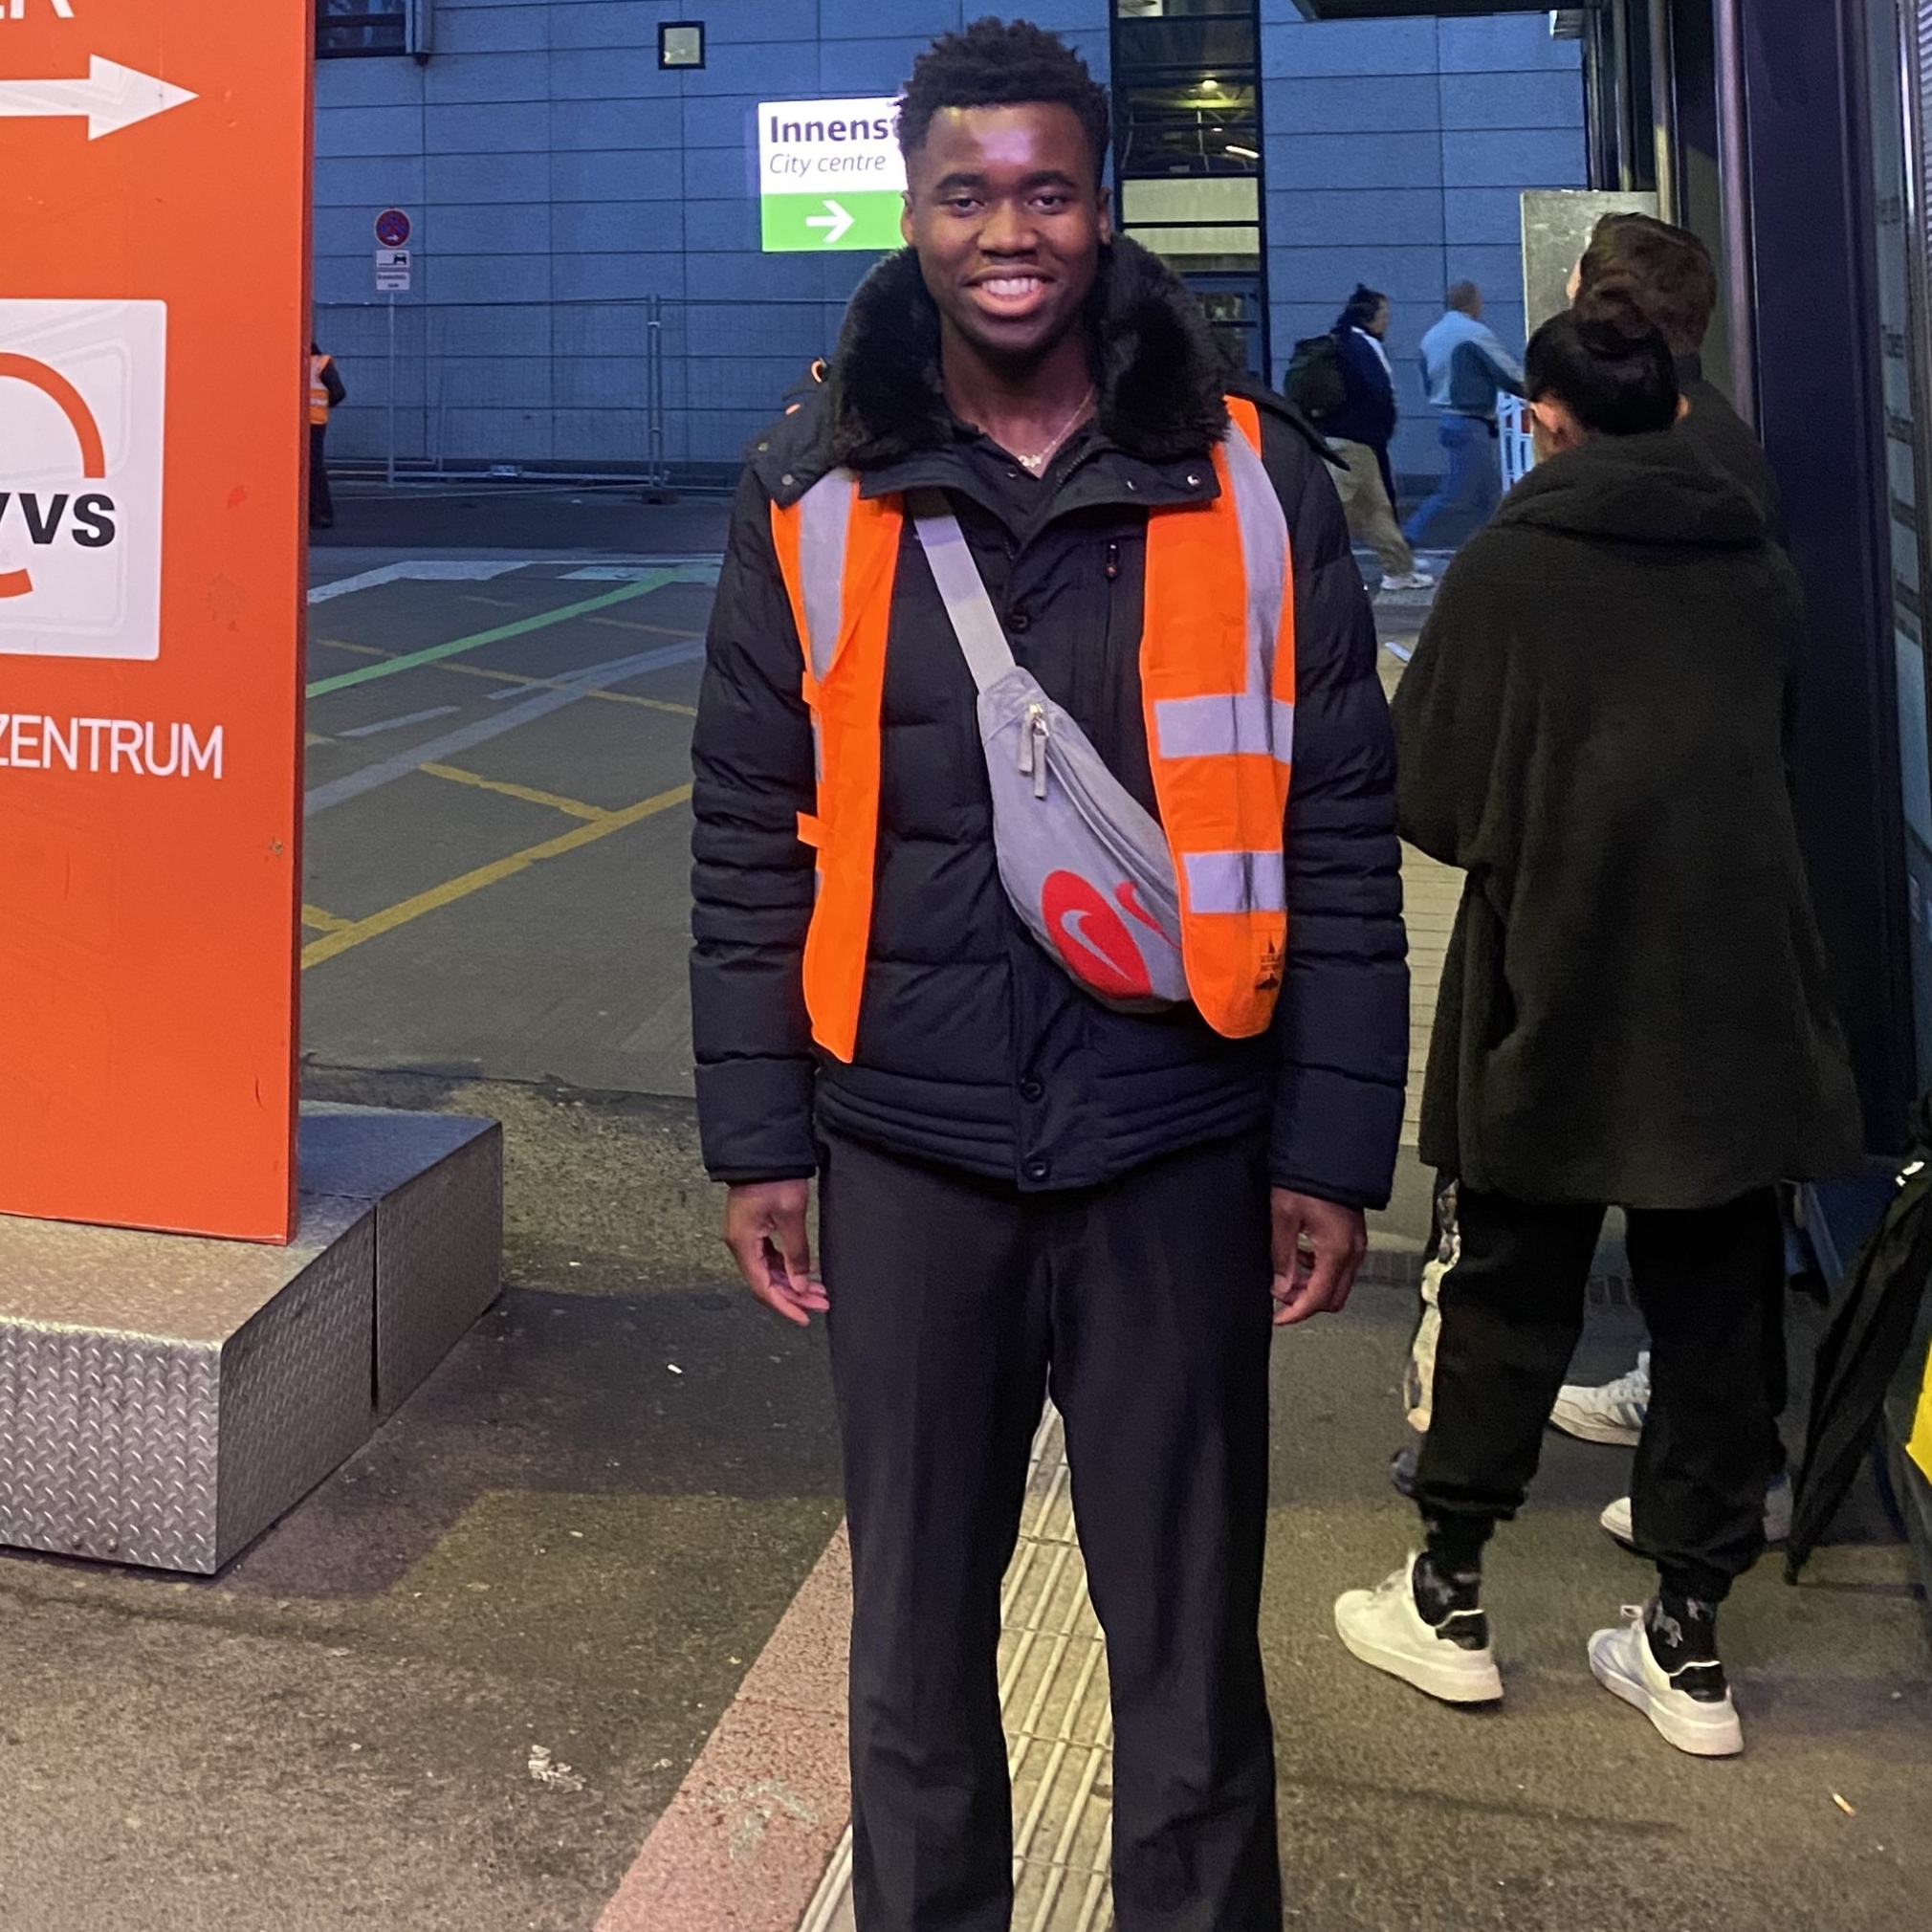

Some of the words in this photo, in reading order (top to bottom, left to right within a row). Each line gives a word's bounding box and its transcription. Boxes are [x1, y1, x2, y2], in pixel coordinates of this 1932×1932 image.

[770, 116, 889, 143] Innens
[769, 153, 811, 177] City
[817, 154, 886, 172] centre
[0, 492, 116, 548] VS
